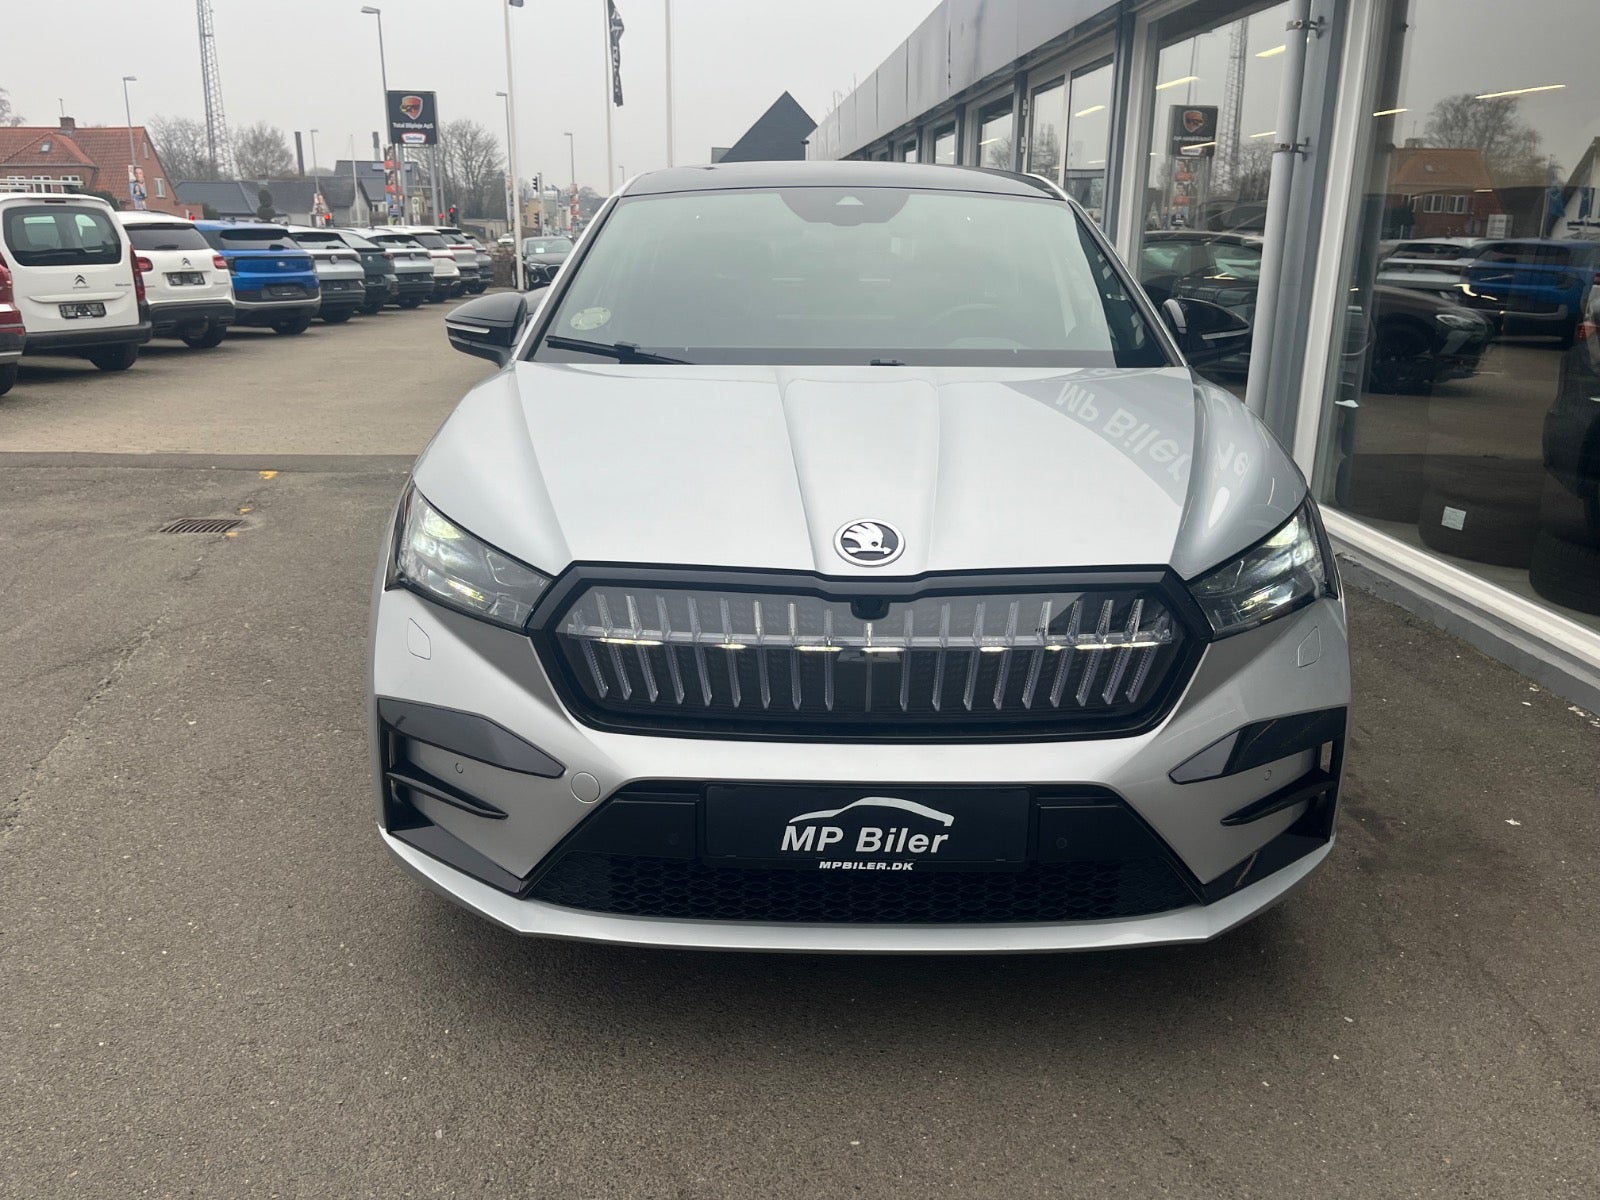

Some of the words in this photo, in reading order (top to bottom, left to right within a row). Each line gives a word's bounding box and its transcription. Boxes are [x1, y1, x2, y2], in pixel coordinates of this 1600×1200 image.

[781, 825, 844, 852] MP
[855, 827, 949, 853] Biler
[818, 861, 914, 871] MPBILER.DK
